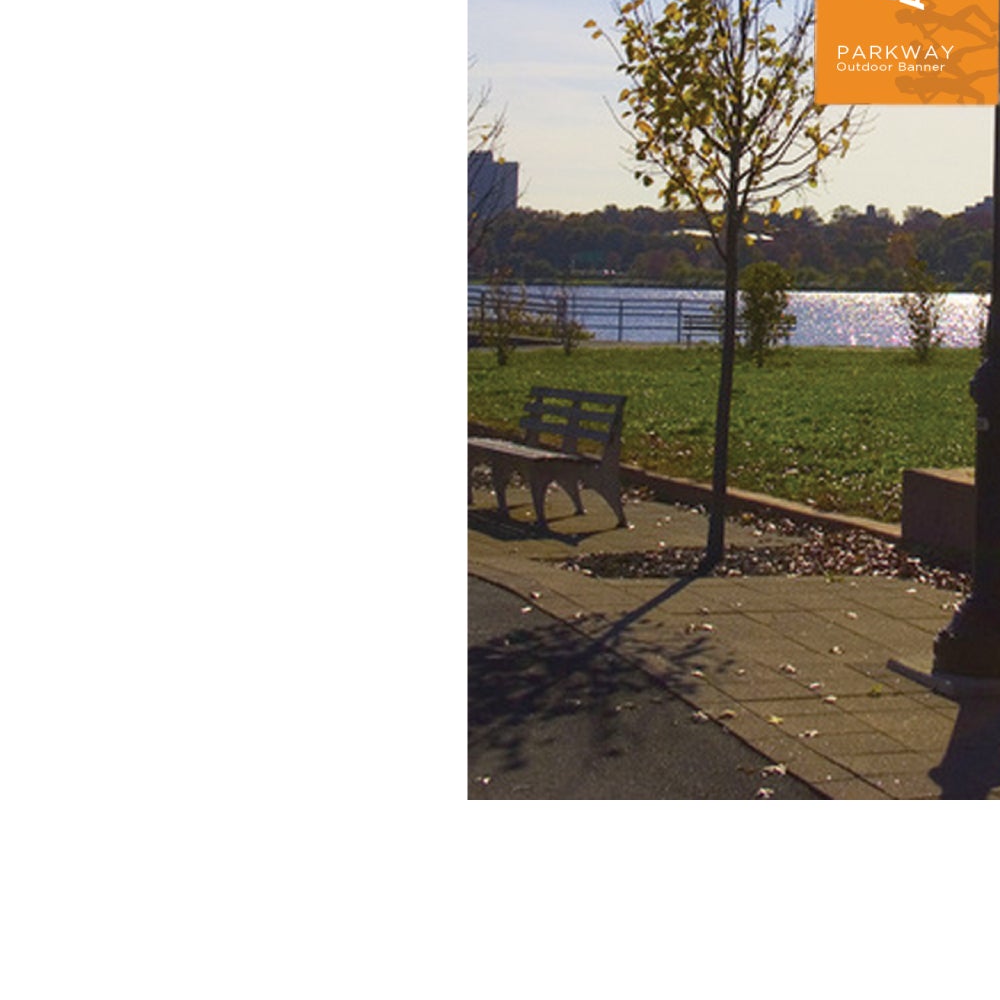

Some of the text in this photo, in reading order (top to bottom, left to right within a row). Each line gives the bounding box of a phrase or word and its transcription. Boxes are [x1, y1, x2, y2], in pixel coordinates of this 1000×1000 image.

[837, 45, 955, 60] PARKWAY
[836, 62, 946, 72] Outdoor Banner
